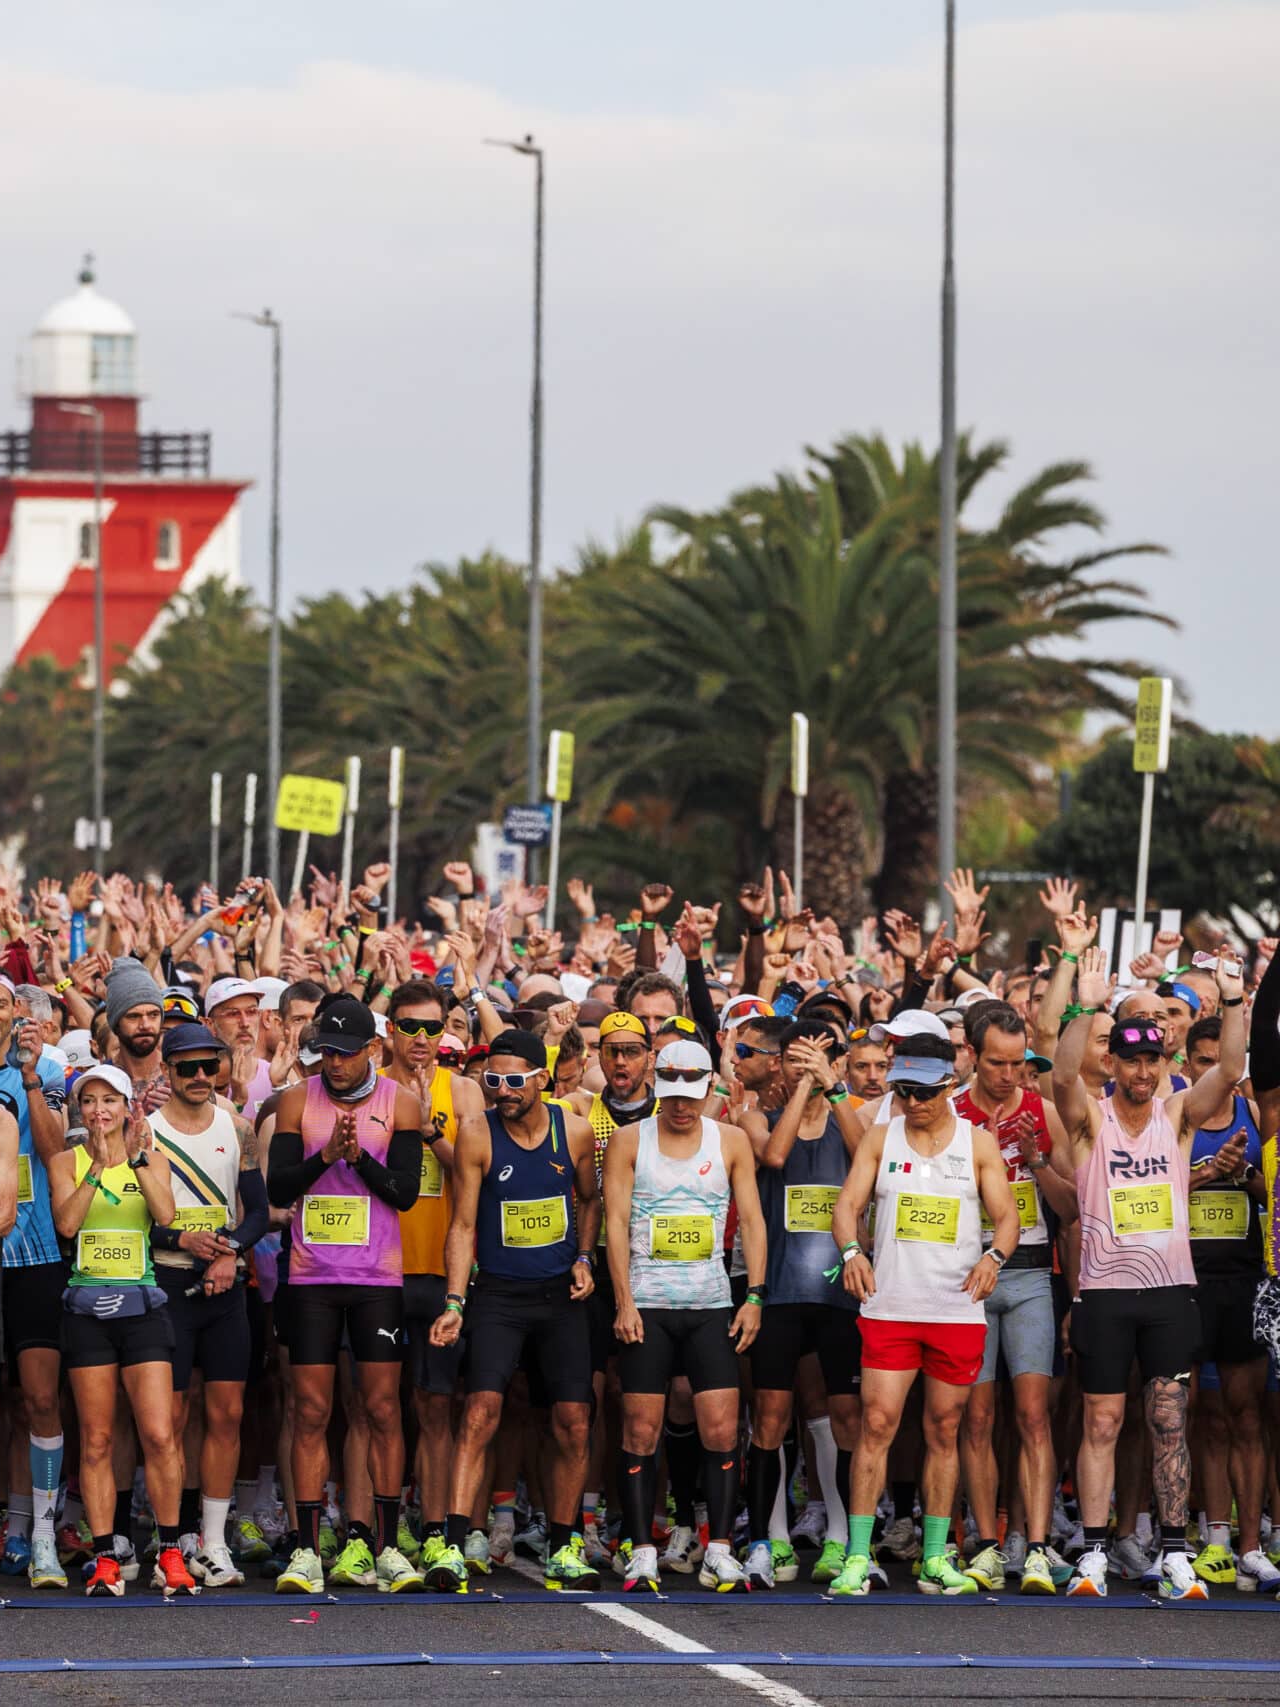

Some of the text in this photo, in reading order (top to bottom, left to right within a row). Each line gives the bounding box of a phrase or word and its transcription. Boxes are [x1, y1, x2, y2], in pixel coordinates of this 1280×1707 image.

[1109, 1149, 1170, 1179] RUN
[1129, 1200, 1160, 1215] 1313
[1201, 1207, 1234, 1221] 1878
[320, 1213, 352, 1226] 1877
[520, 1215, 551, 1230] 1013
[909, 1209, 946, 1225] 2322
[668, 1231, 701, 1244] 2133
[93, 1247, 131, 1260] 2689
